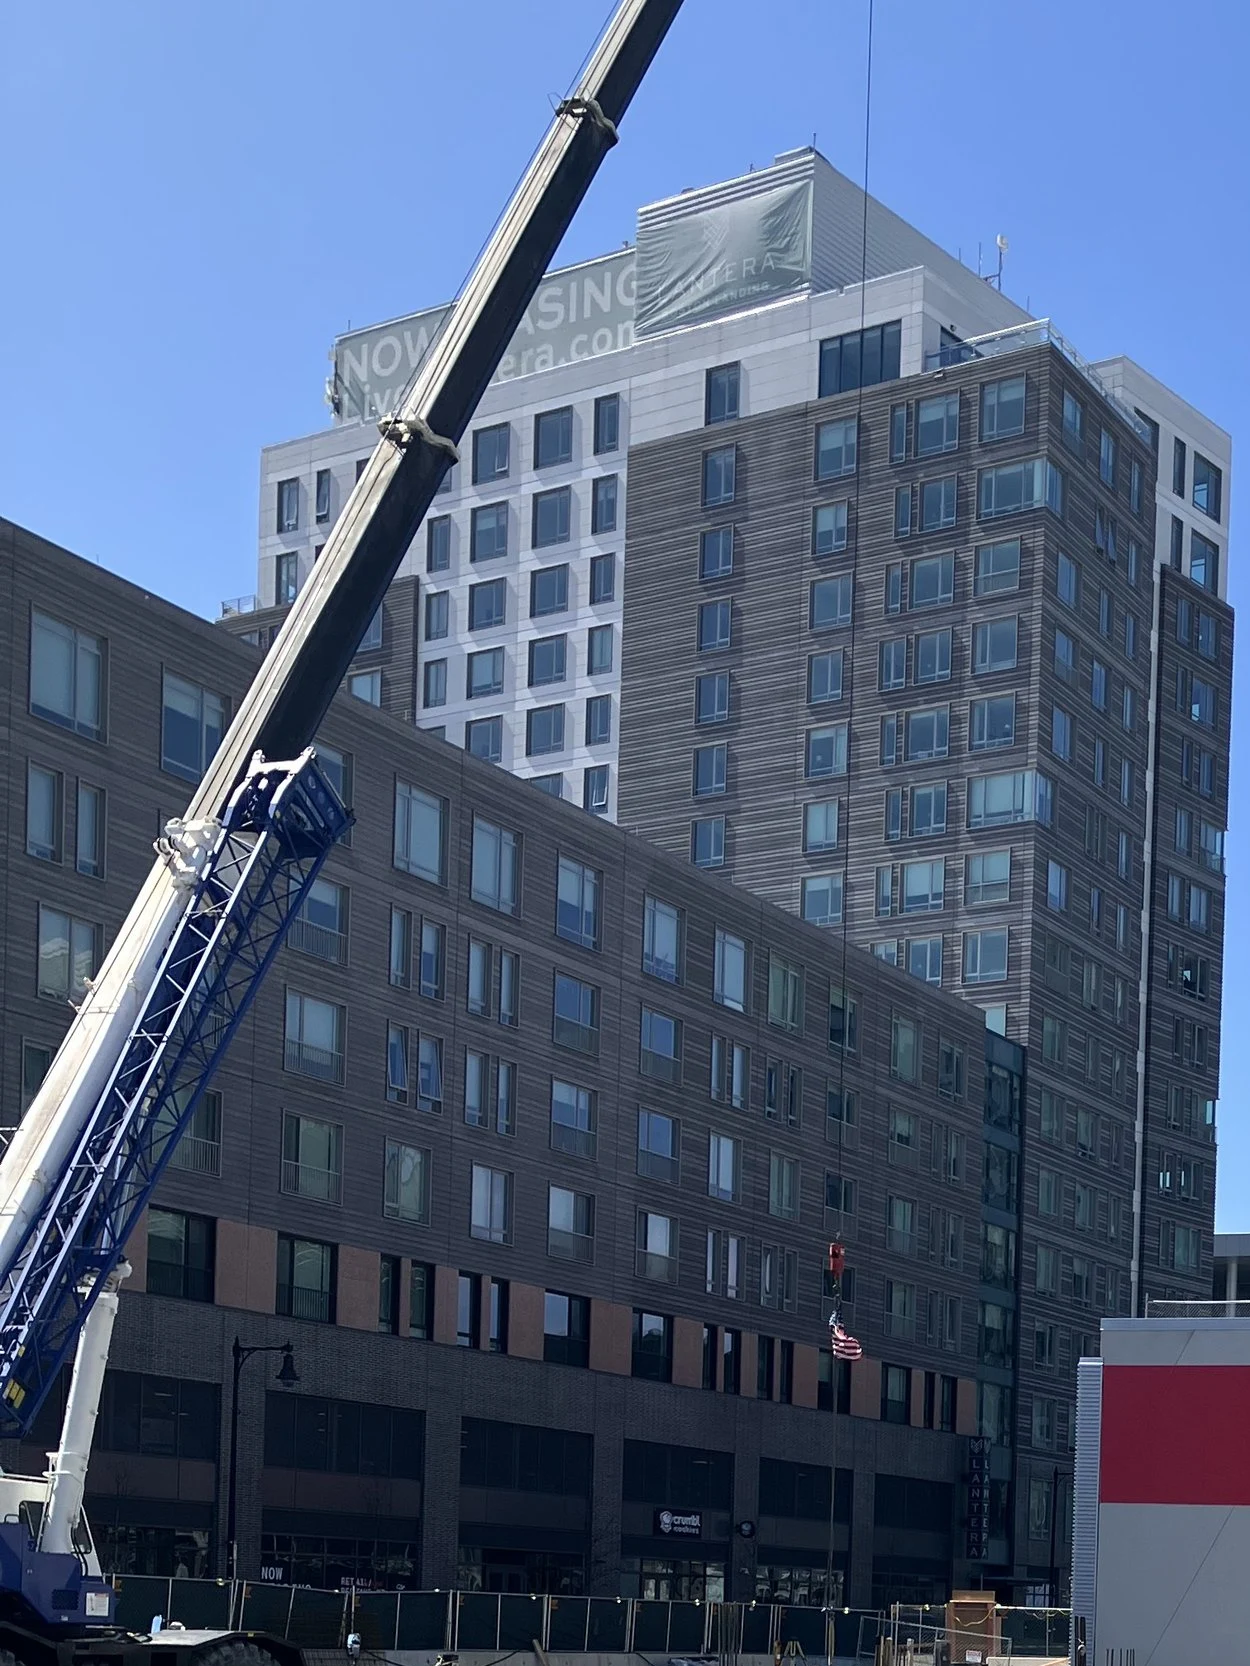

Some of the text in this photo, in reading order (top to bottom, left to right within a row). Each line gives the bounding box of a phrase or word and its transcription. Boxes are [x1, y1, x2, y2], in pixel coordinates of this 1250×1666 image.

[343, 262, 637, 388] NOW ASING
[673, 1515, 701, 1526] crumbl
[673, 1526, 700, 1534] cookies
[971, 1459, 980, 1556] LANTERA
[981, 1459, 989, 1559] LANTERA
[261, 1566, 283, 1581] NOW
